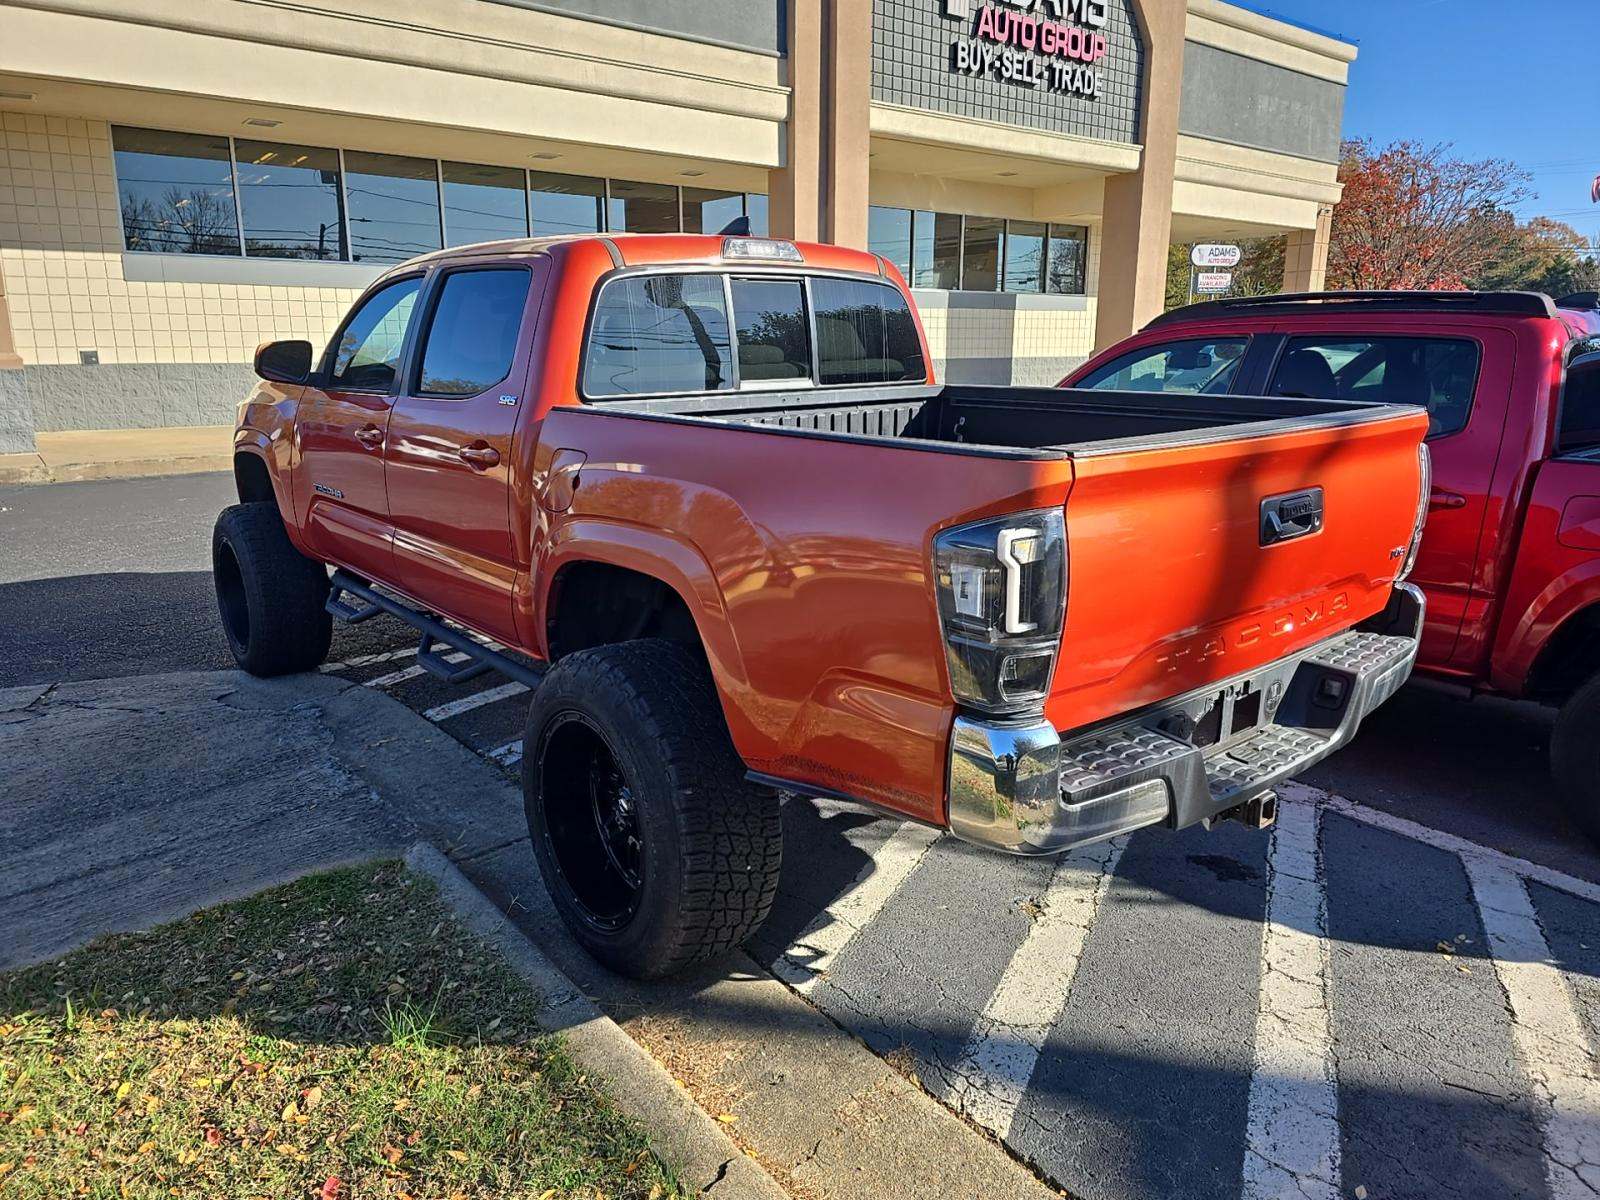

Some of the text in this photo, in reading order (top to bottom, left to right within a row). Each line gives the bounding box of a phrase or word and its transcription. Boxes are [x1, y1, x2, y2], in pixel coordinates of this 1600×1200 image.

[978, 5, 1036, 49] AUTO
[1041, 22, 1106, 62] GROUP
[957, 40, 1103, 97] BUY SELL TRADE
[1208, 247, 1237, 257] ADAMS
[312, 482, 344, 499] TACOMA
[1156, 591, 1349, 673] TACOMA
